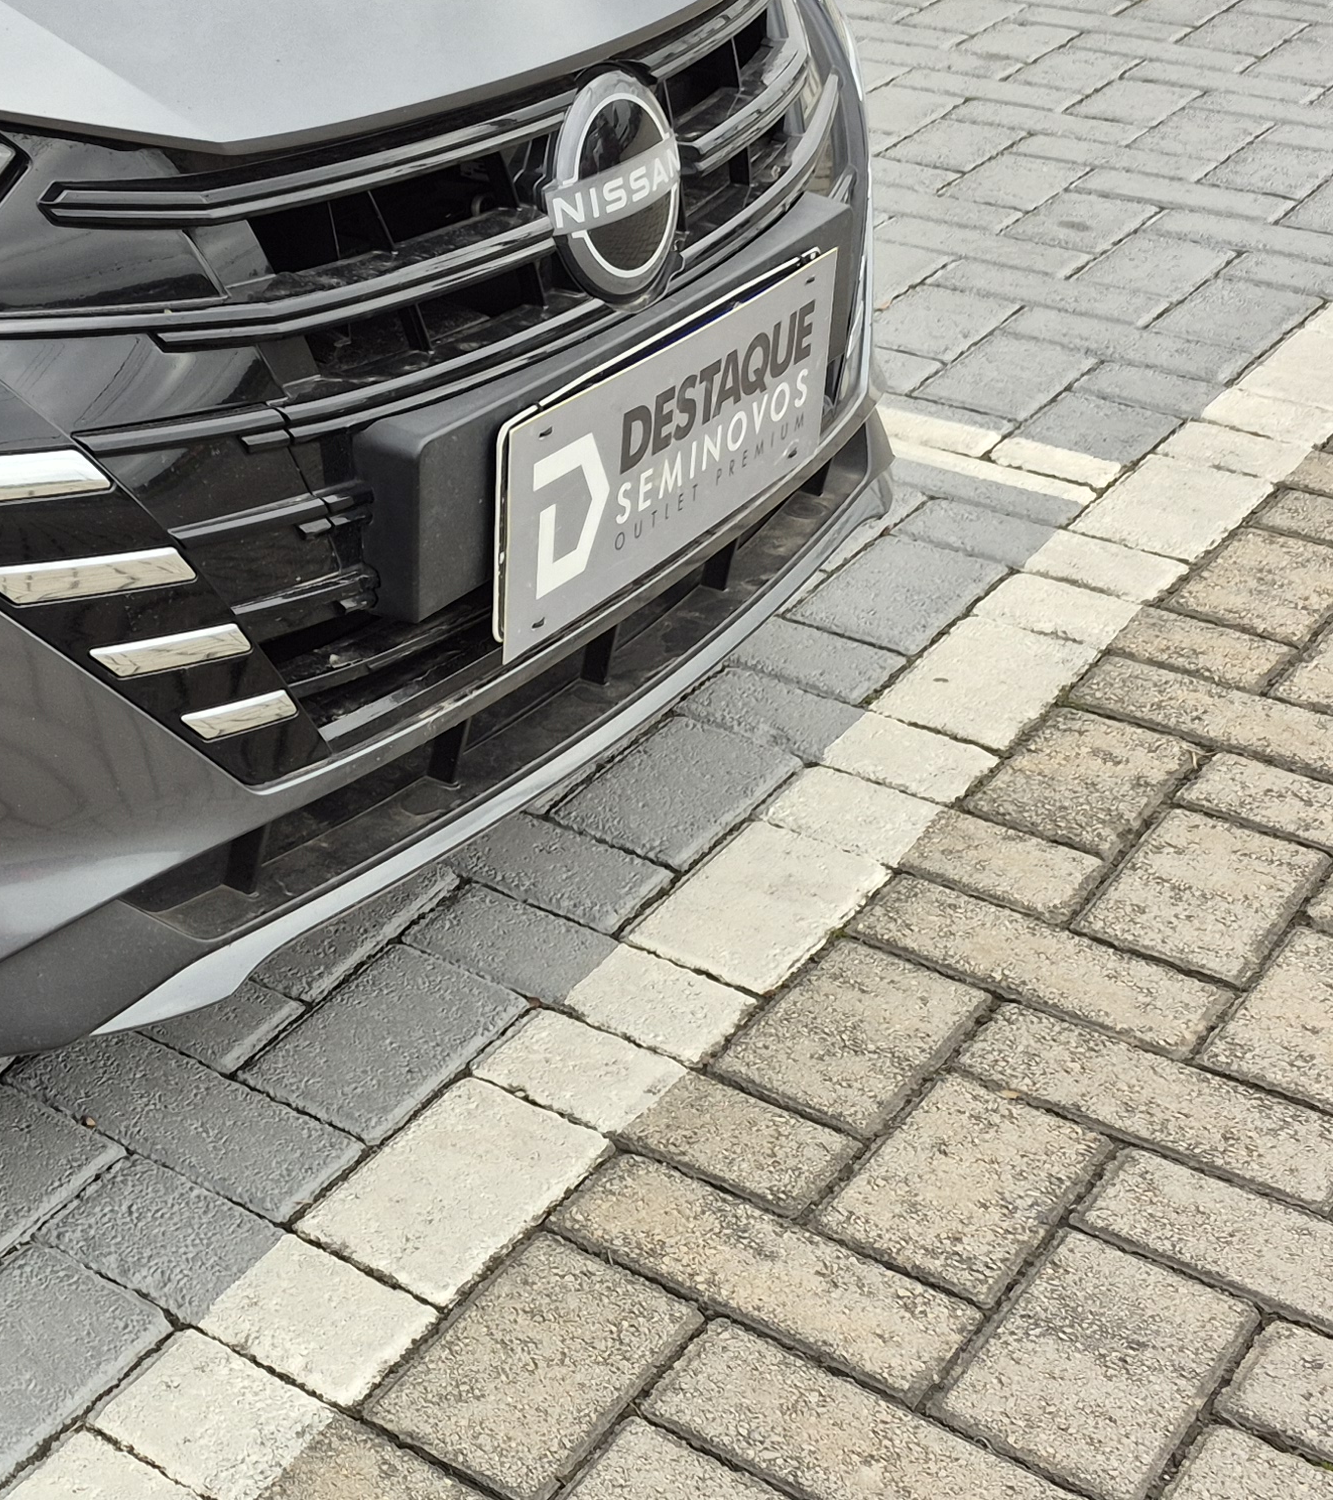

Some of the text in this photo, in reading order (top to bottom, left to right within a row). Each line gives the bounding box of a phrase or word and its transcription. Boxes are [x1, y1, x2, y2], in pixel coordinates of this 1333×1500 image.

[552, 148, 681, 229] NISSAN
[615, 368, 809, 525] SEMINOVOS
[620, 300, 816, 475] DESTAQUE
[614, 418, 805, 551] OUTLET PREMIUM
